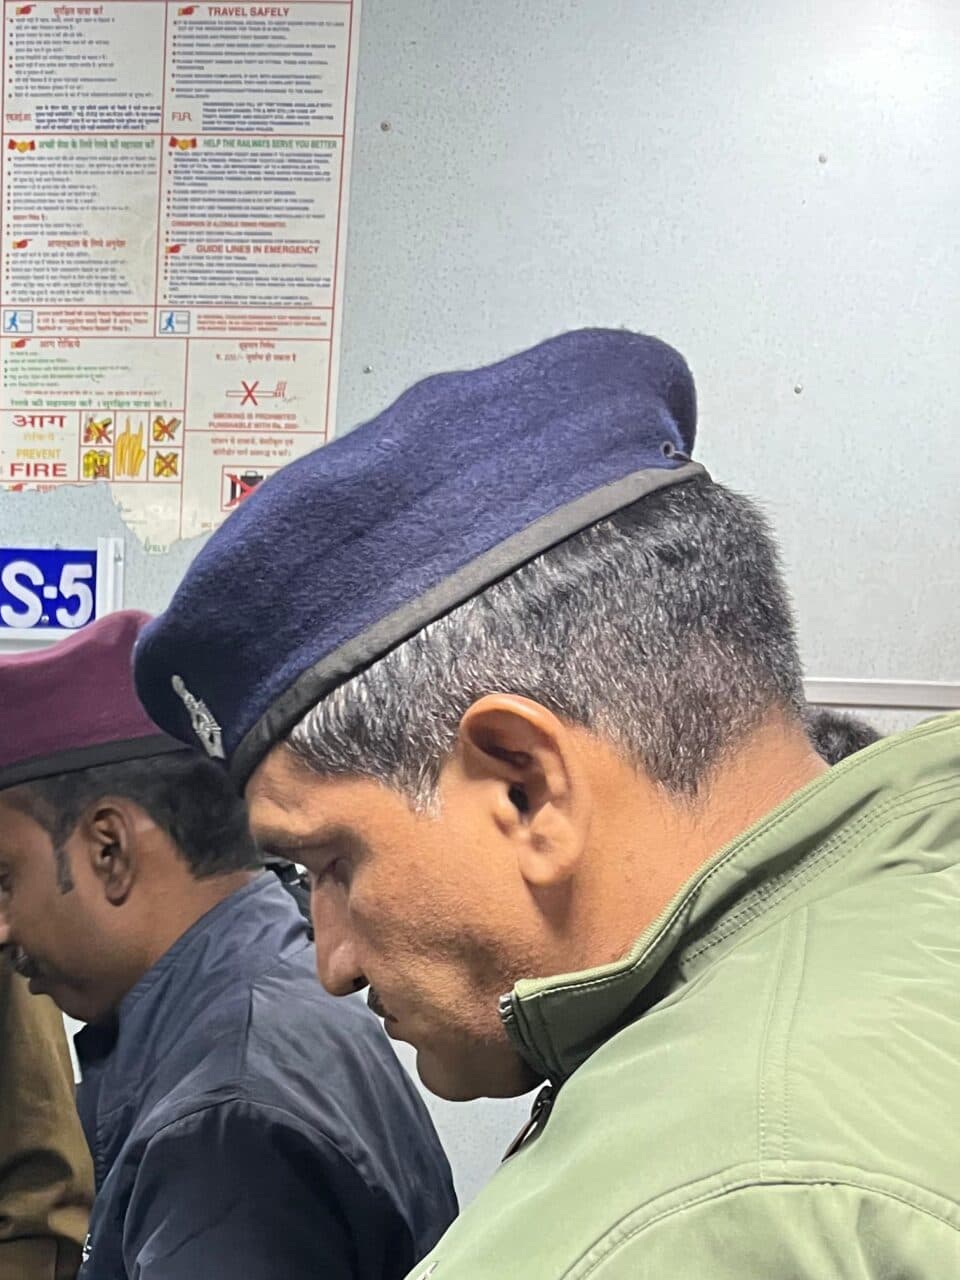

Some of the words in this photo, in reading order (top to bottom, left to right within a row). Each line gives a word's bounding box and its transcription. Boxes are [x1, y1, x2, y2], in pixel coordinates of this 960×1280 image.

[207, 6, 248, 17] TRAVEL
[250, 6, 290, 17] SAFELY
[203, 139, 221, 148] HELP
[222, 139, 236, 148] THE
[237, 139, 271, 148] RAILWAYS
[272, 140, 295, 149] SERVE
[295, 140, 310, 149] YOU
[311, 140, 337, 149] BETTER
[196, 244, 224, 254] GUIDE
[225, 244, 251, 254] LINES
[253, 245, 262, 254] IN
[264, 245, 319, 254] EMERGENCY
[12, 414, 67, 428] आग
[16, 447, 62, 459] PREVENT
[10, 462, 67, 477] FIRE
[0, 560, 94, 629] S-5
